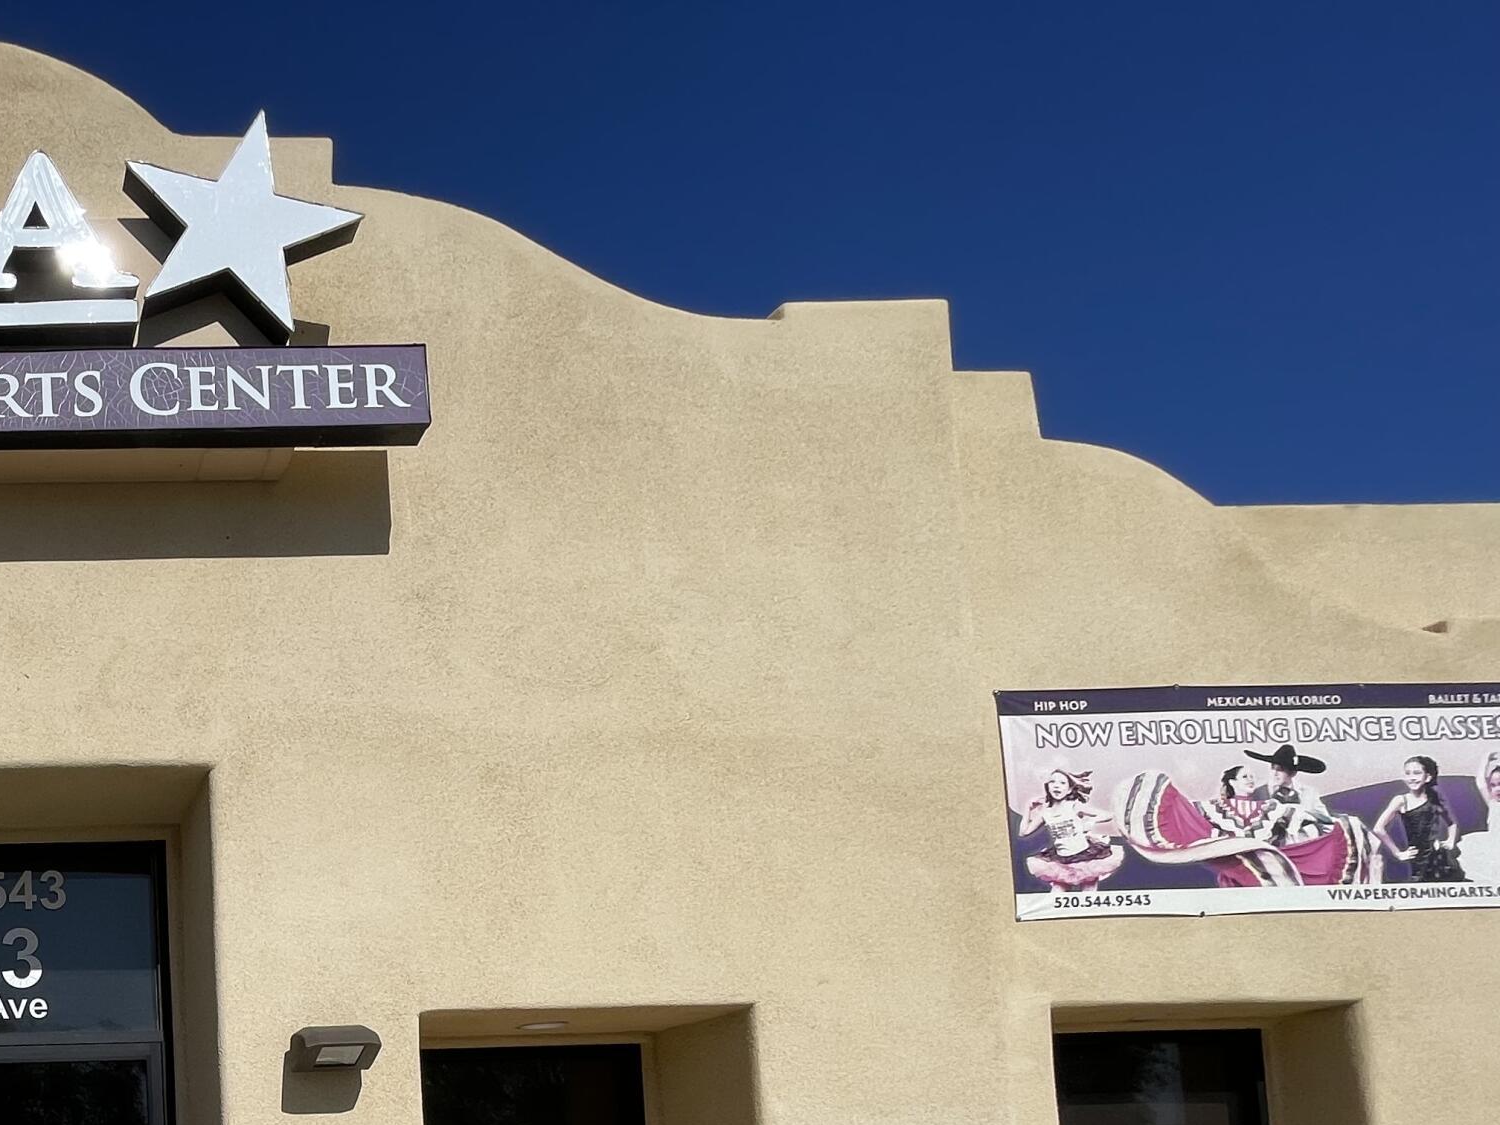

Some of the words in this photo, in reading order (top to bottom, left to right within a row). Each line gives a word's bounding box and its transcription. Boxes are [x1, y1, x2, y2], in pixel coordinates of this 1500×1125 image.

[128, 361, 412, 417] CENTER
[1034, 701, 1056, 712] HIP
[1059, 700, 1088, 711] HOP
[1206, 695, 1263, 707] MEXICAN
[1265, 694, 1342, 706] FOLKLORICO
[1428, 694, 1470, 704] BALLET
[1035, 721, 1113, 748] NOW
[1119, 717, 1291, 746] ENROLLING
[1295, 716, 1396, 743] DANCE
[1053, 894, 1152, 909] 520.544.9543
